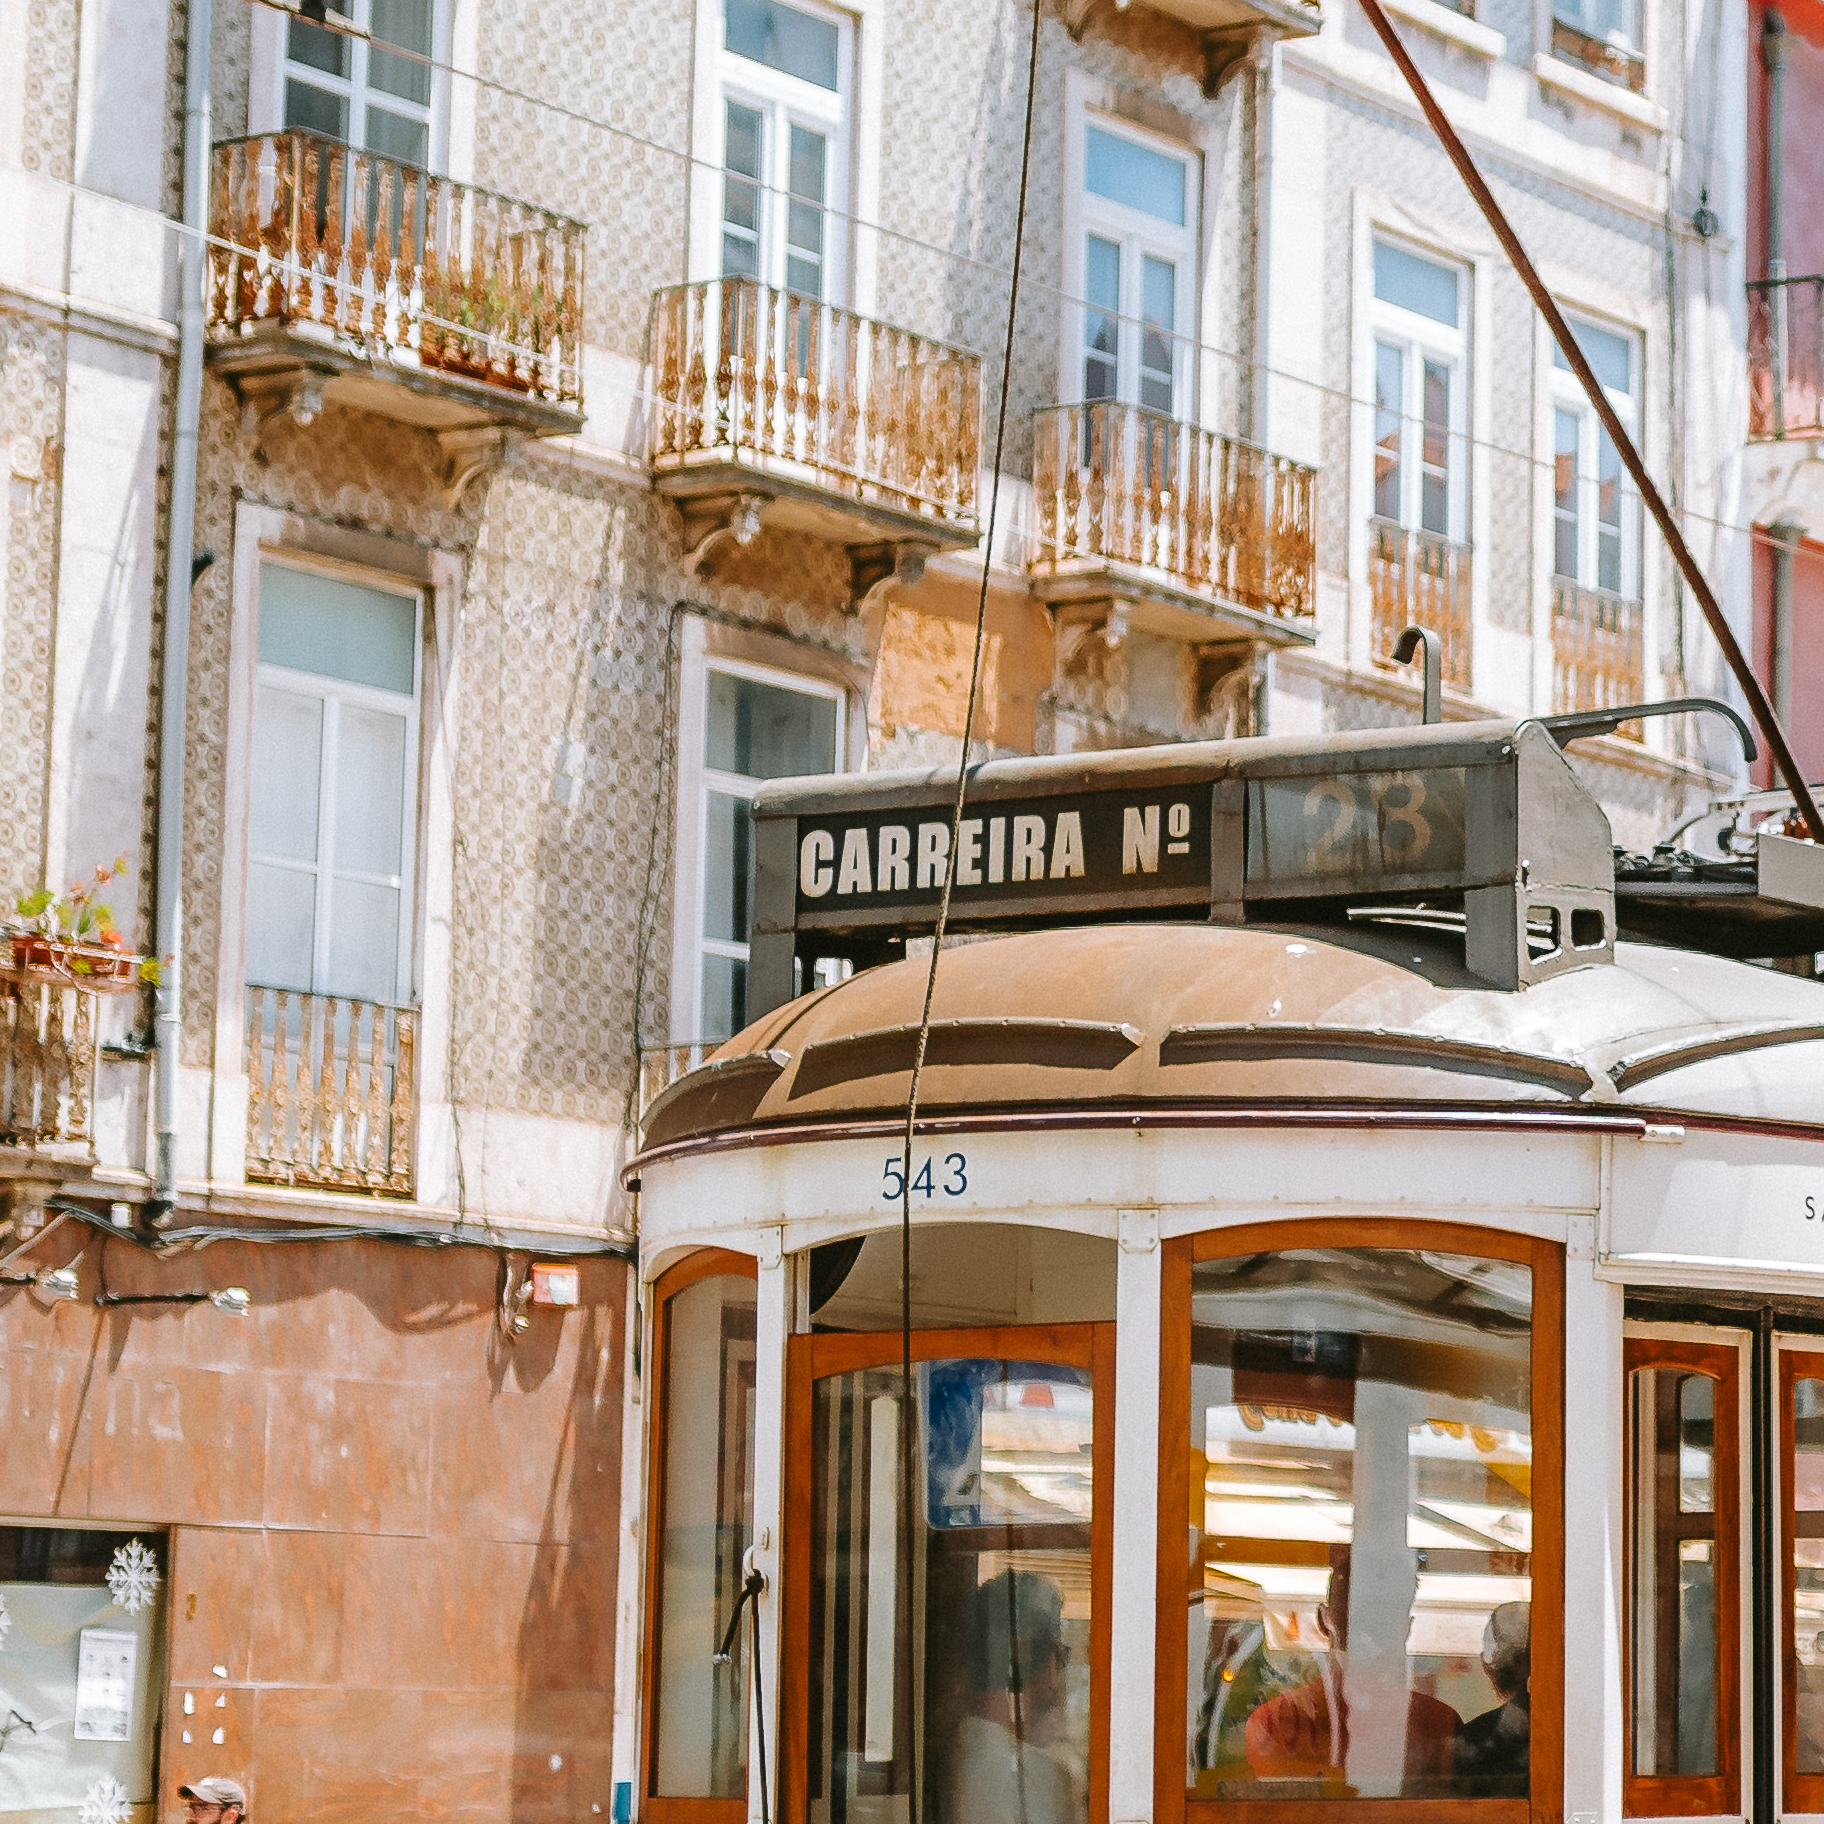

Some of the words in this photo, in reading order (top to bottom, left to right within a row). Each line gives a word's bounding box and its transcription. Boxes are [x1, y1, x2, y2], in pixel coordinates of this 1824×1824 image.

[800, 811, 1086, 897] CARREIRA
[1123, 803, 1191, 875] Nº
[1303, 770, 1431, 873] 28
[882, 1152, 968, 1200] 543
